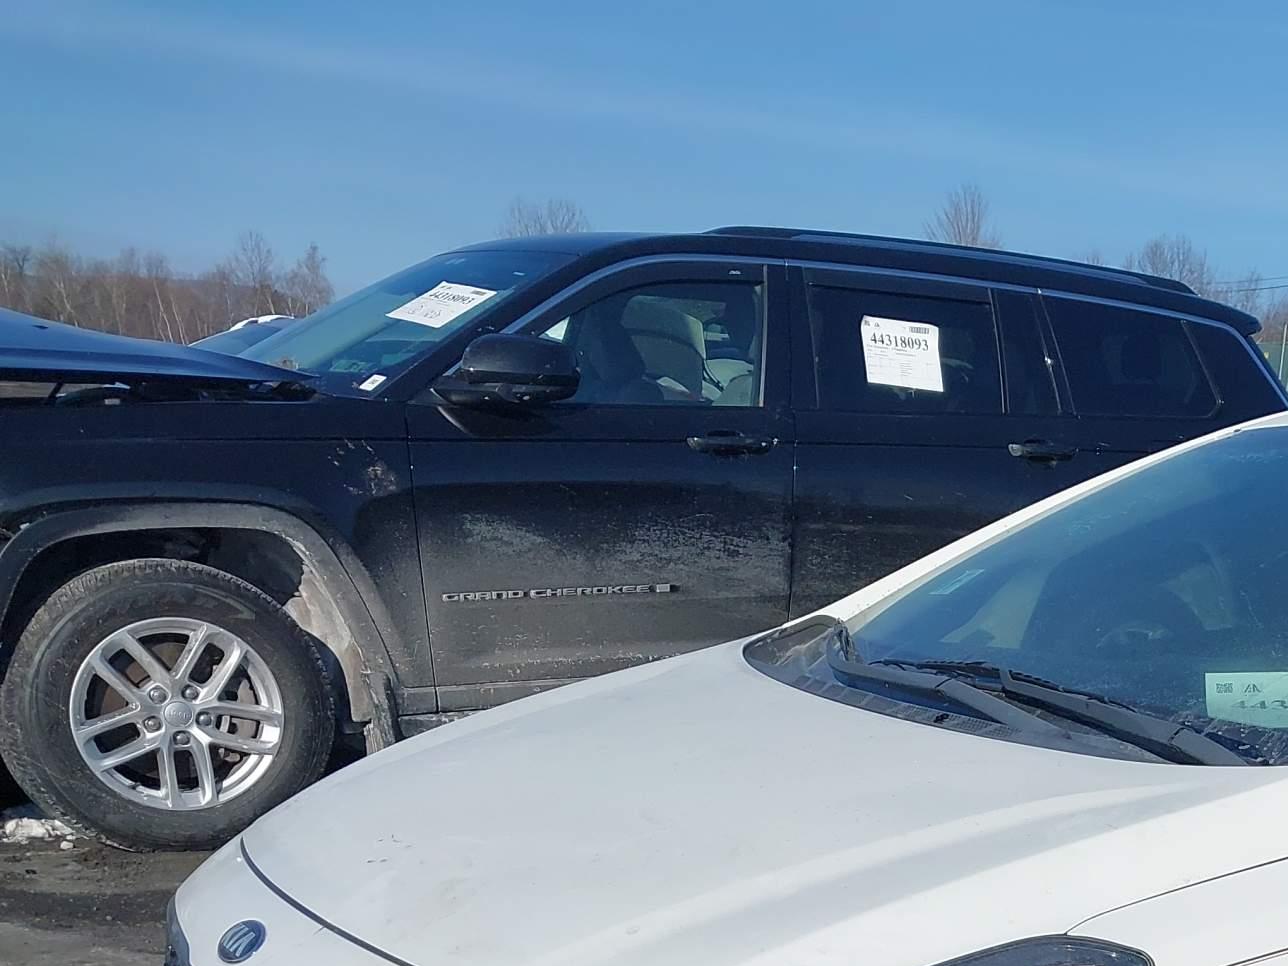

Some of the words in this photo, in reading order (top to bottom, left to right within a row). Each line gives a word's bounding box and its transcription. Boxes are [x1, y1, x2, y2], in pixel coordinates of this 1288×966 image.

[870, 331, 929, 352] 44318093
[442, 590, 524, 602] GRAND
[530, 584, 651, 599] CHEROKEE
